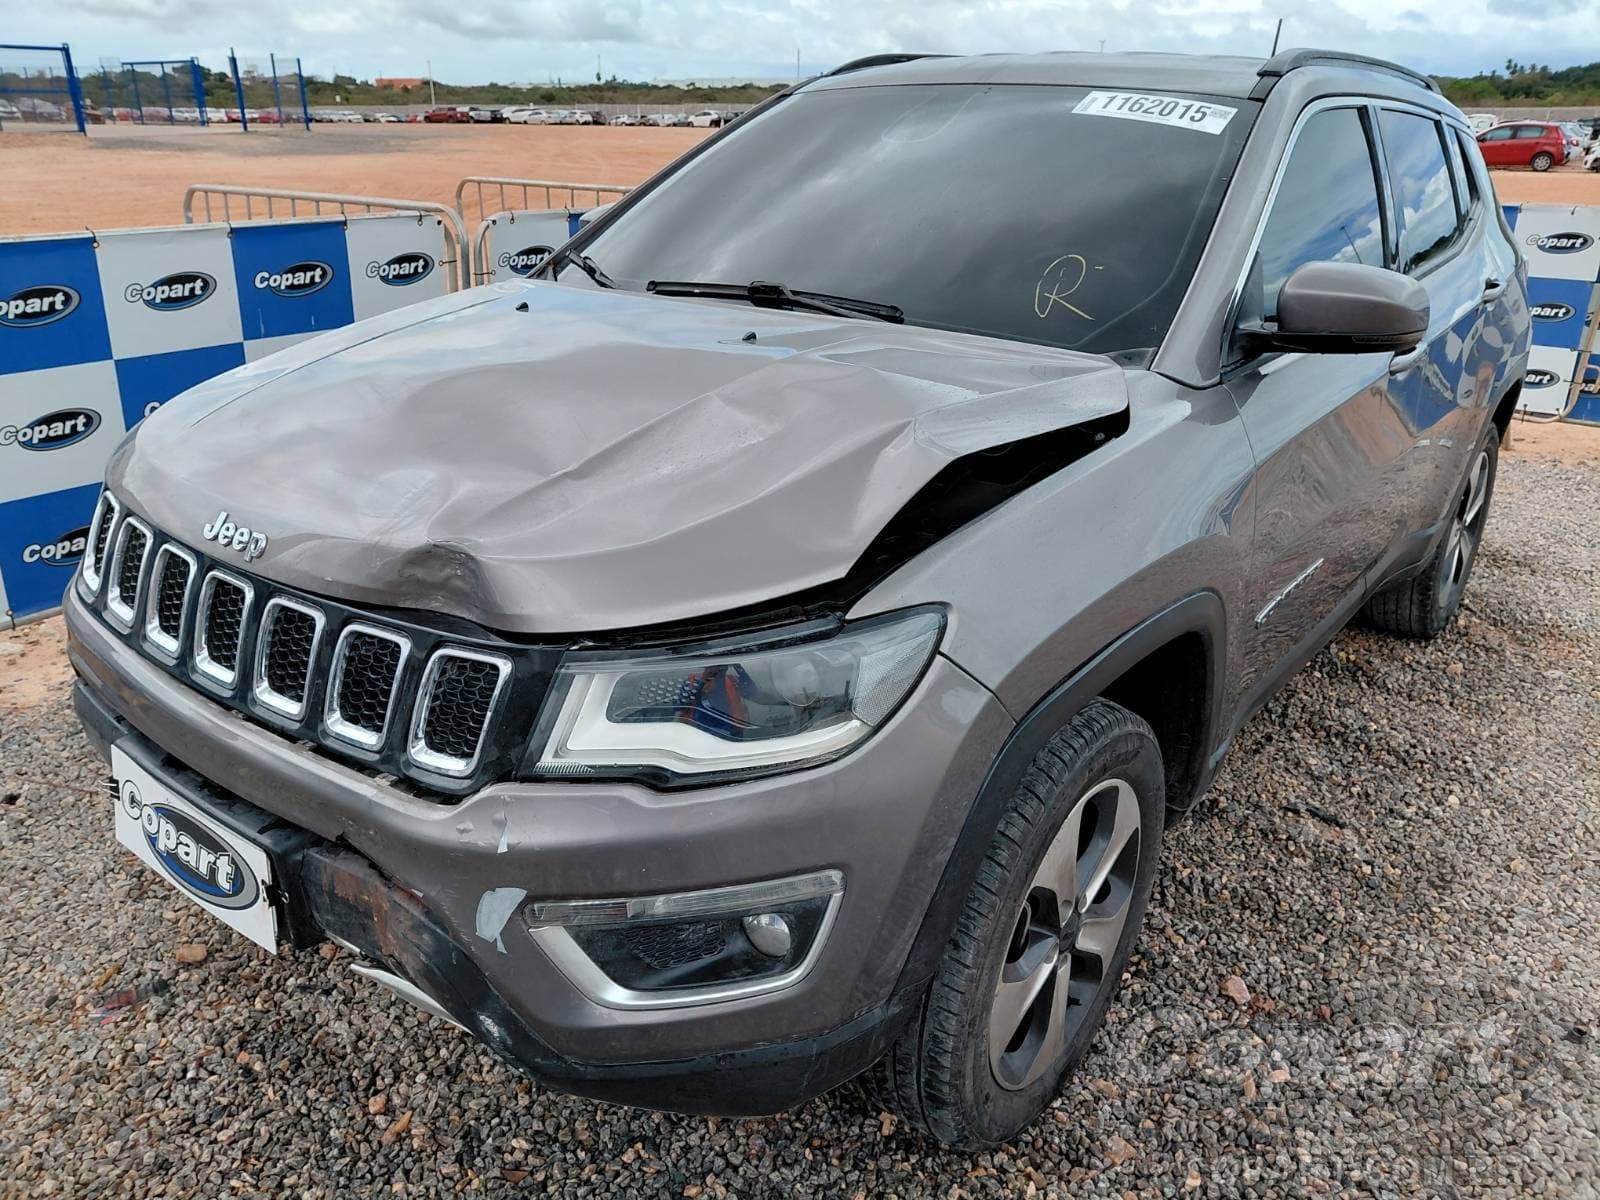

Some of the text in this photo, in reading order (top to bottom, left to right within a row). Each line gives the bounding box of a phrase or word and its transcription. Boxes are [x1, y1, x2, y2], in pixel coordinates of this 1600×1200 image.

[1101, 94, 1211, 123] 1162015
[1526, 234, 1584, 249] Copart
[255, 267, 323, 290] Copart
[366, 258, 425, 278] Copart
[125, 278, 204, 303] Copart
[0, 292, 66, 320] opart
[1530, 306, 1568, 318] part
[0, 414, 87, 446] Copart
[22, 535, 87, 564] Copa
[203, 511, 269, 563] Jeep
[122, 779, 235, 894] Copart
